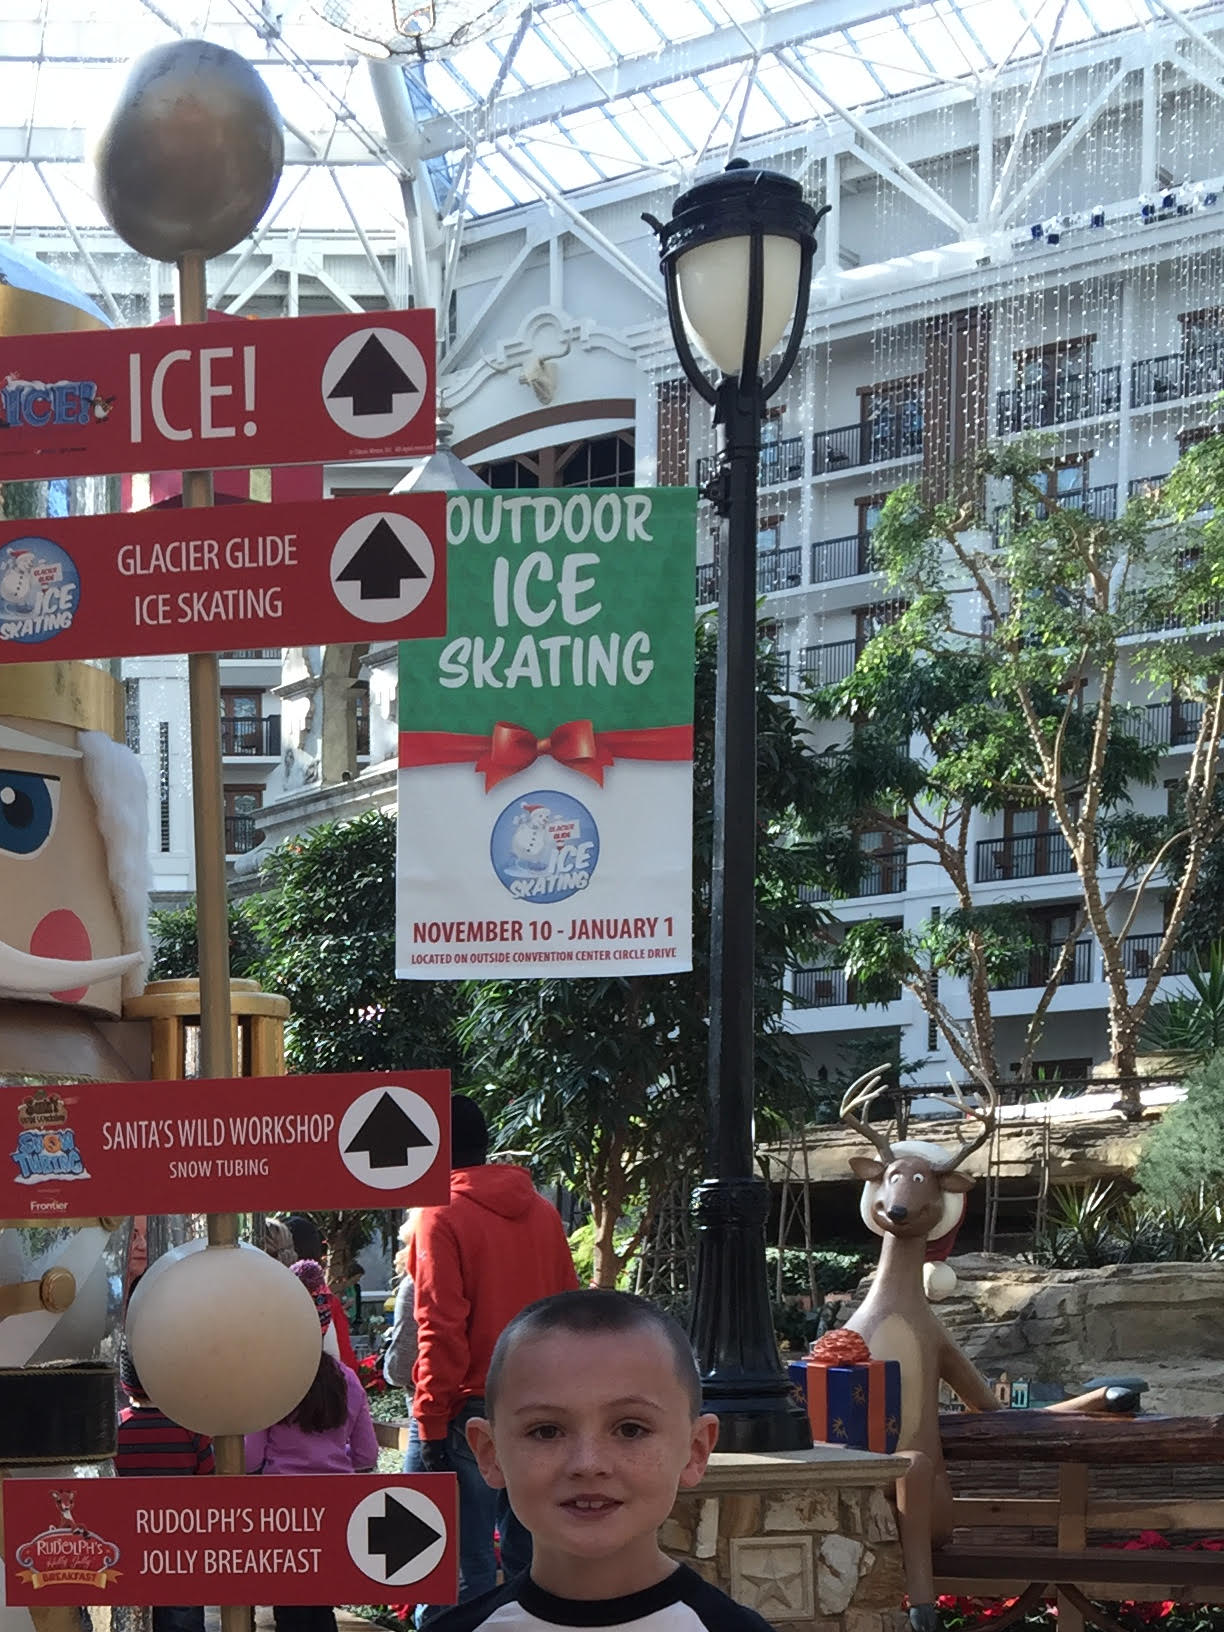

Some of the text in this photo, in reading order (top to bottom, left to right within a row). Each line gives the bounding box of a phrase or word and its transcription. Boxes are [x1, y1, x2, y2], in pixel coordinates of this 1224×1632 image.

[1, 381, 97, 427] ICE!
[129, 345, 257, 444] ICE!
[446, 493, 654, 546] OUTDOOR
[116, 534, 298, 576] GLACIER GLIDE
[33, 583, 76, 617] ICE
[135, 587, 283, 626] ICE SKATING
[493, 551, 602, 628] ICE
[0, 611, 73, 640] SKATING
[438, 631, 655, 690] SKATING
[548, 841, 595, 875] ICE
[510, 870, 590, 899] SKATING
[413, 921, 524, 943] NOVEMBER
[529, 920, 552, 941] 10
[568, 917, 658, 941] JANUARY
[664, 917, 673, 937] 1
[411, 947, 677, 965] LOCATED ON OUTSIDE CONVENTION CENTER CIRCLE DRIVE
[102, 1113, 335, 1151] SANTA'S WILD WORKSHOP
[169, 1158, 270, 1179] SNOW TUBING
[30, 1201, 69, 1211] Frontier
[136, 1507, 326, 1534] RUDOLPH'S HOLLY
[140, 1548, 322, 1576] JOLLY BREAKFAST
